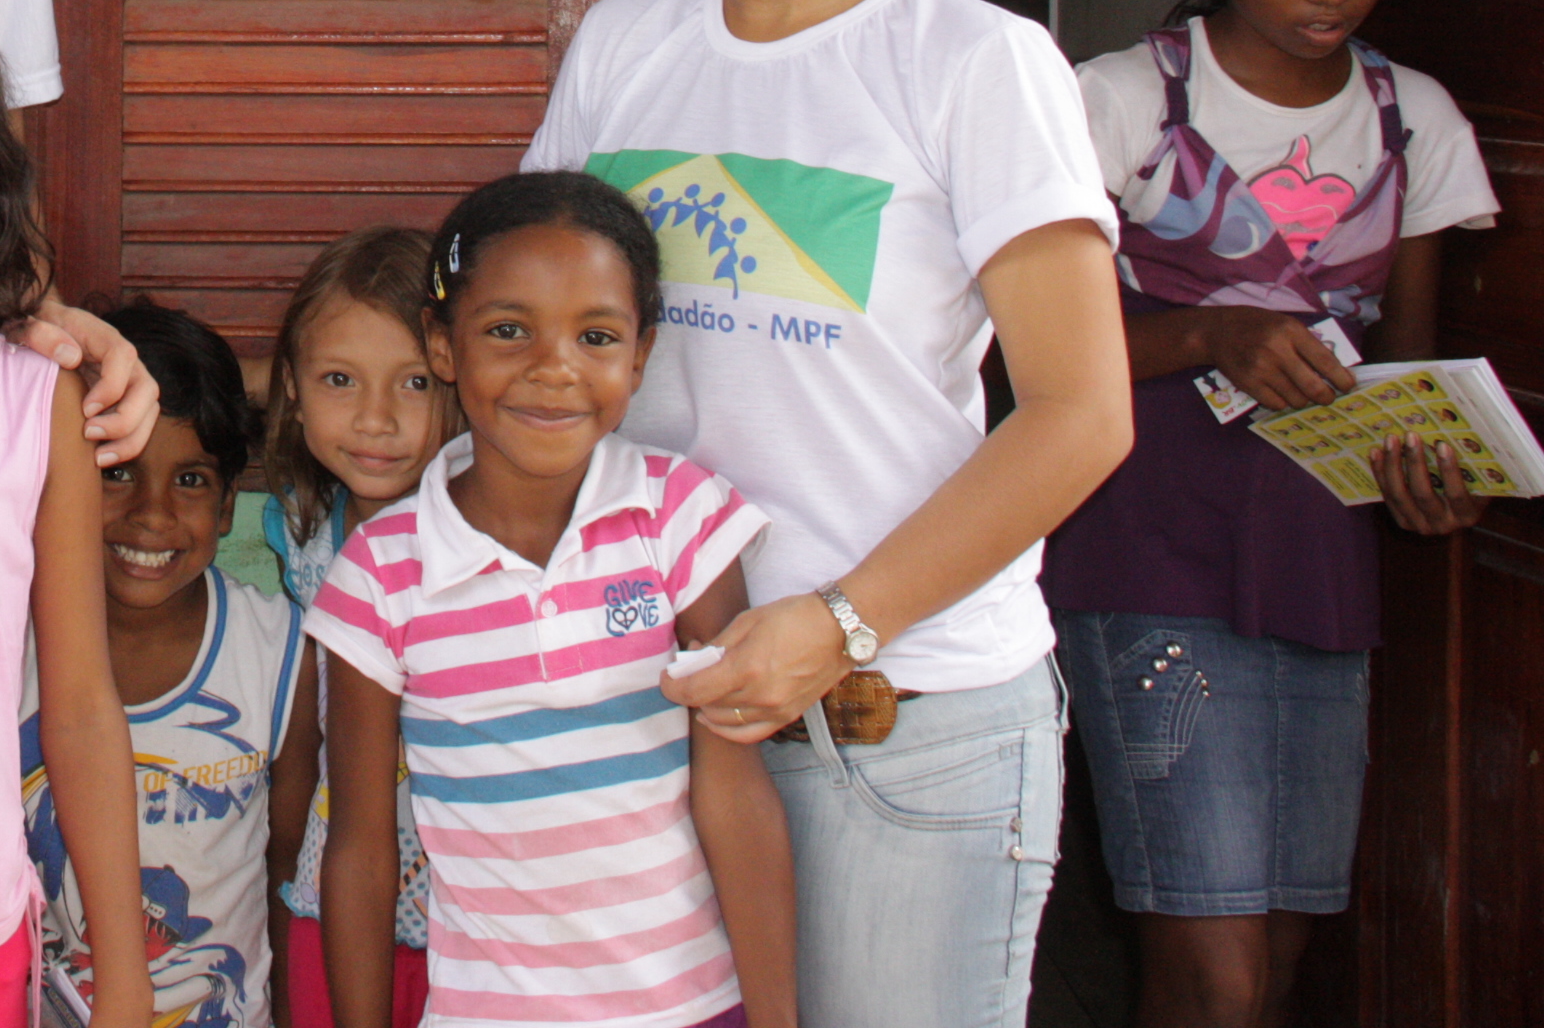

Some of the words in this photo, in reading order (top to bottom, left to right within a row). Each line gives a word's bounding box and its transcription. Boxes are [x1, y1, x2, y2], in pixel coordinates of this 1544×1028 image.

[657, 296, 736, 333] dadão
[770, 313, 842, 349] MPF
[603, 579, 658, 608] GIVE
[143, 771, 174, 792] OF
